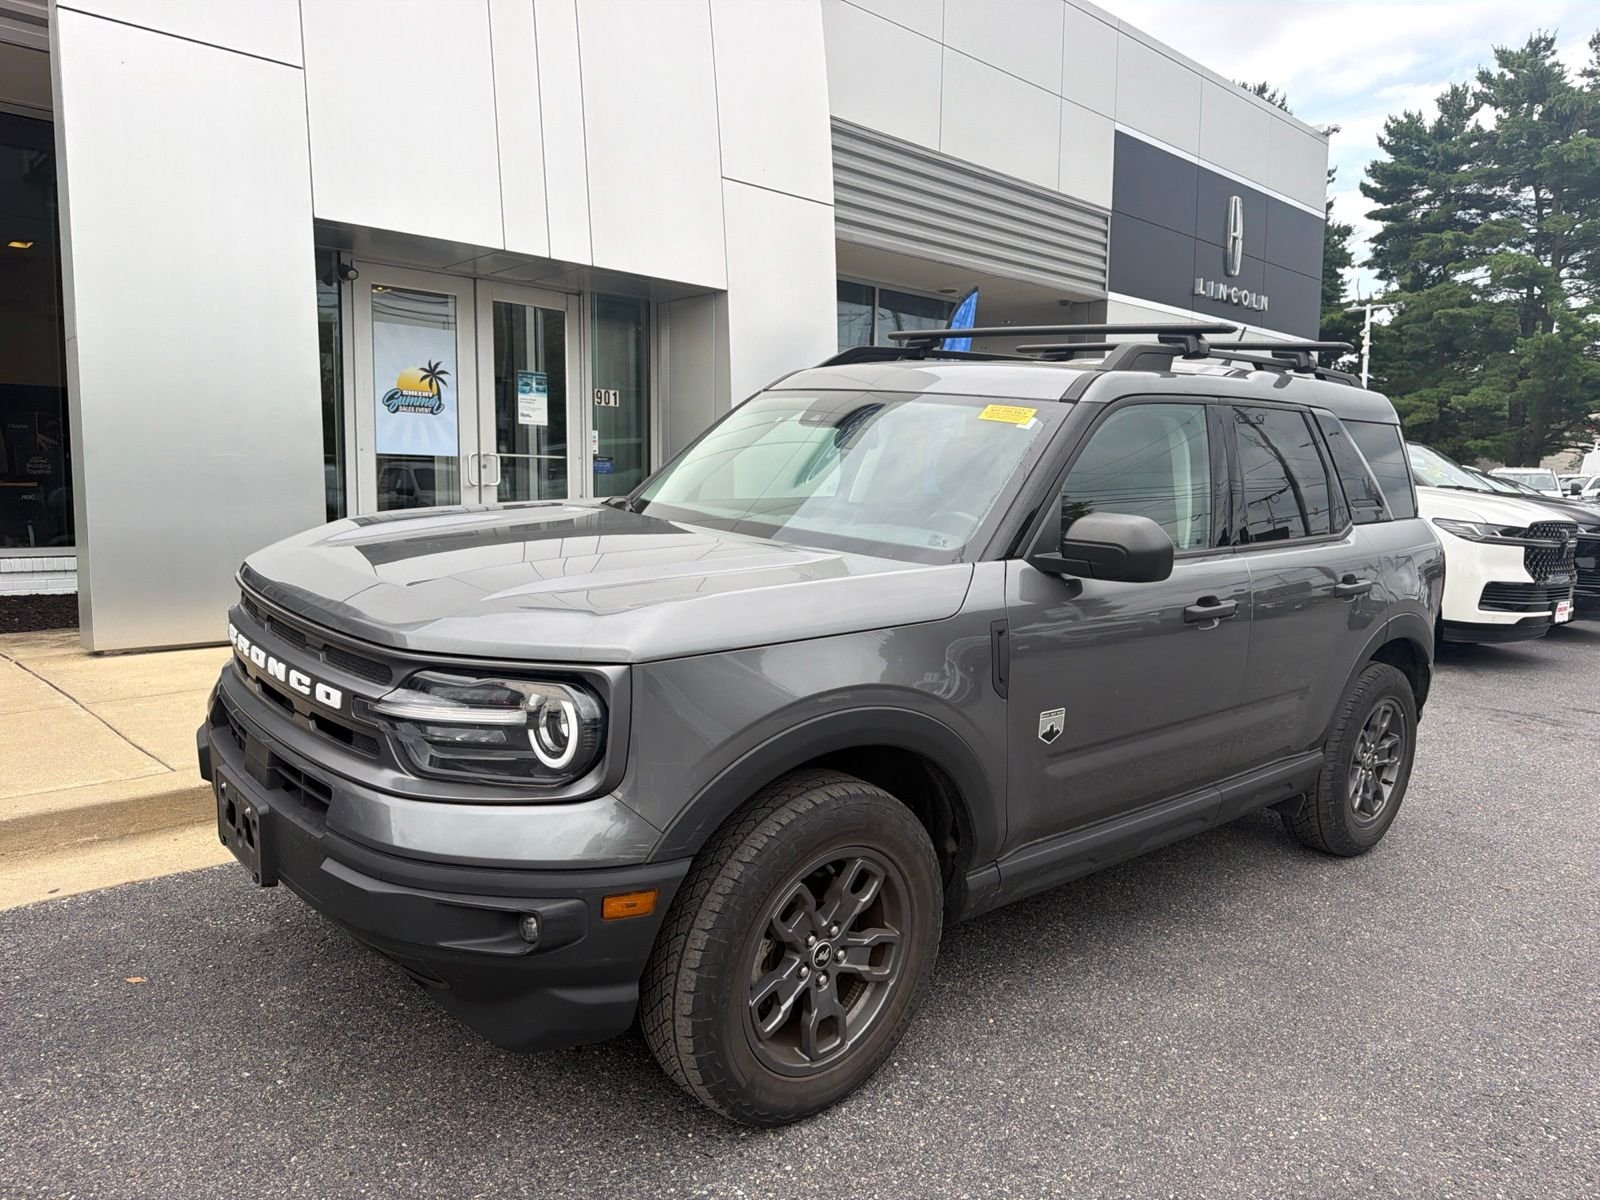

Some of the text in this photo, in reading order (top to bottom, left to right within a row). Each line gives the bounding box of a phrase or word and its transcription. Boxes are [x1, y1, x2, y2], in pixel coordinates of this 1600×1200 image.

[1195, 278, 1269, 311] LINCOLN
[383, 388, 445, 415] Summer
[596, 390, 617, 405] 901
[228, 623, 342, 709] BRONCO
